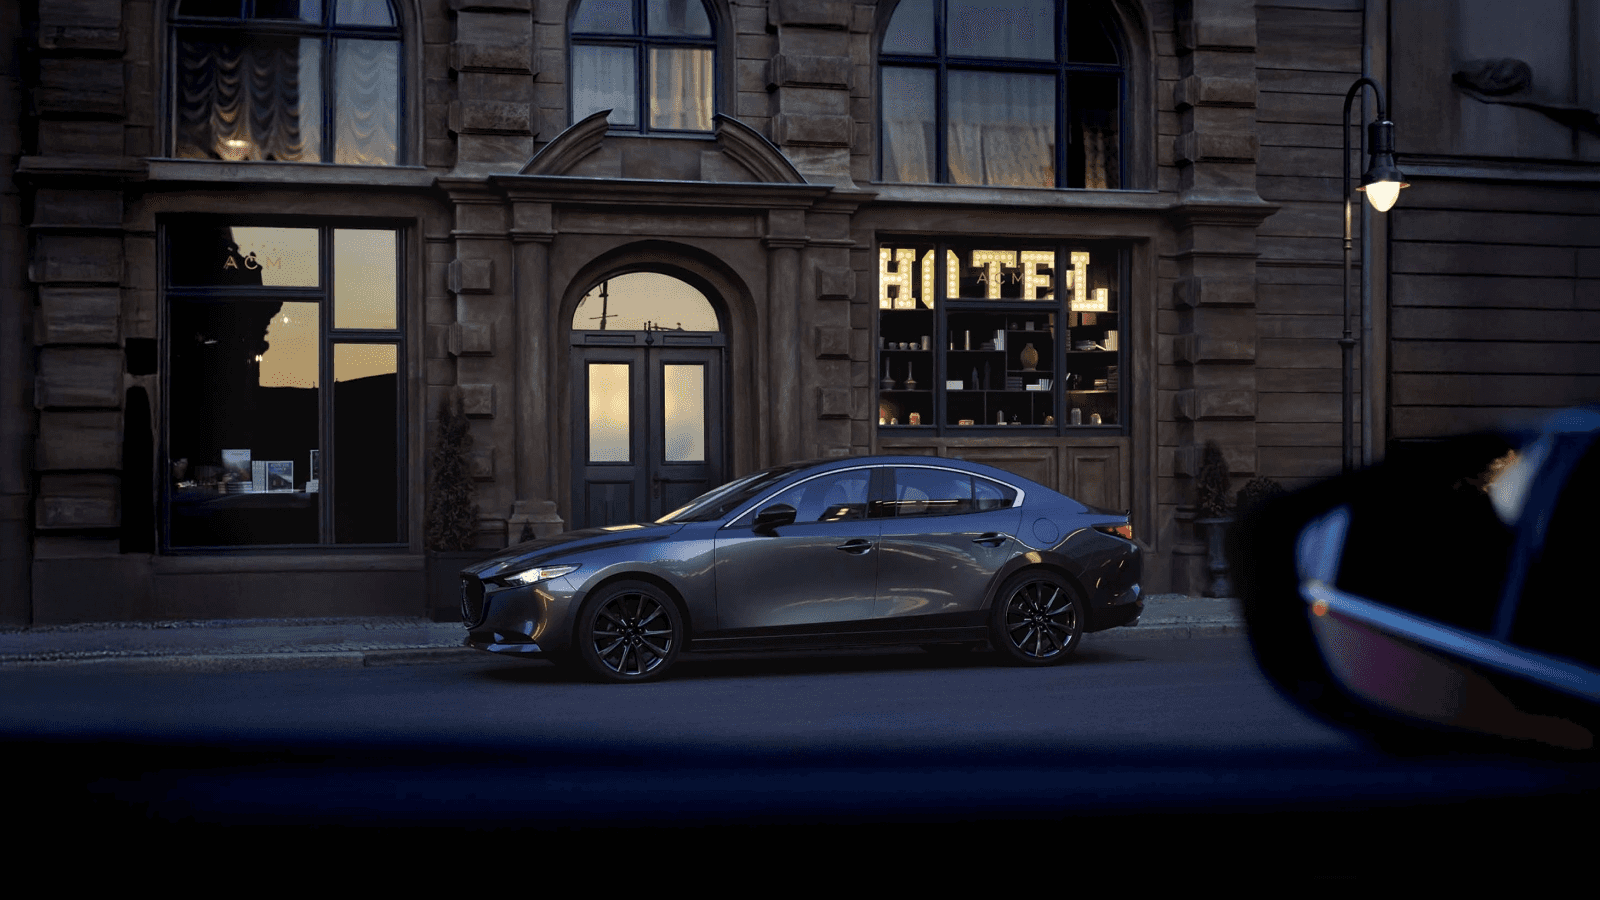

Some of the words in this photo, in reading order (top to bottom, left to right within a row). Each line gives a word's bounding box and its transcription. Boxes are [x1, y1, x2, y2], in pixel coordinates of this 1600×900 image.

[223, 255, 282, 270] ACM
[880, 248, 1108, 311] HOTEL
[976, 271, 1025, 285] ACM
